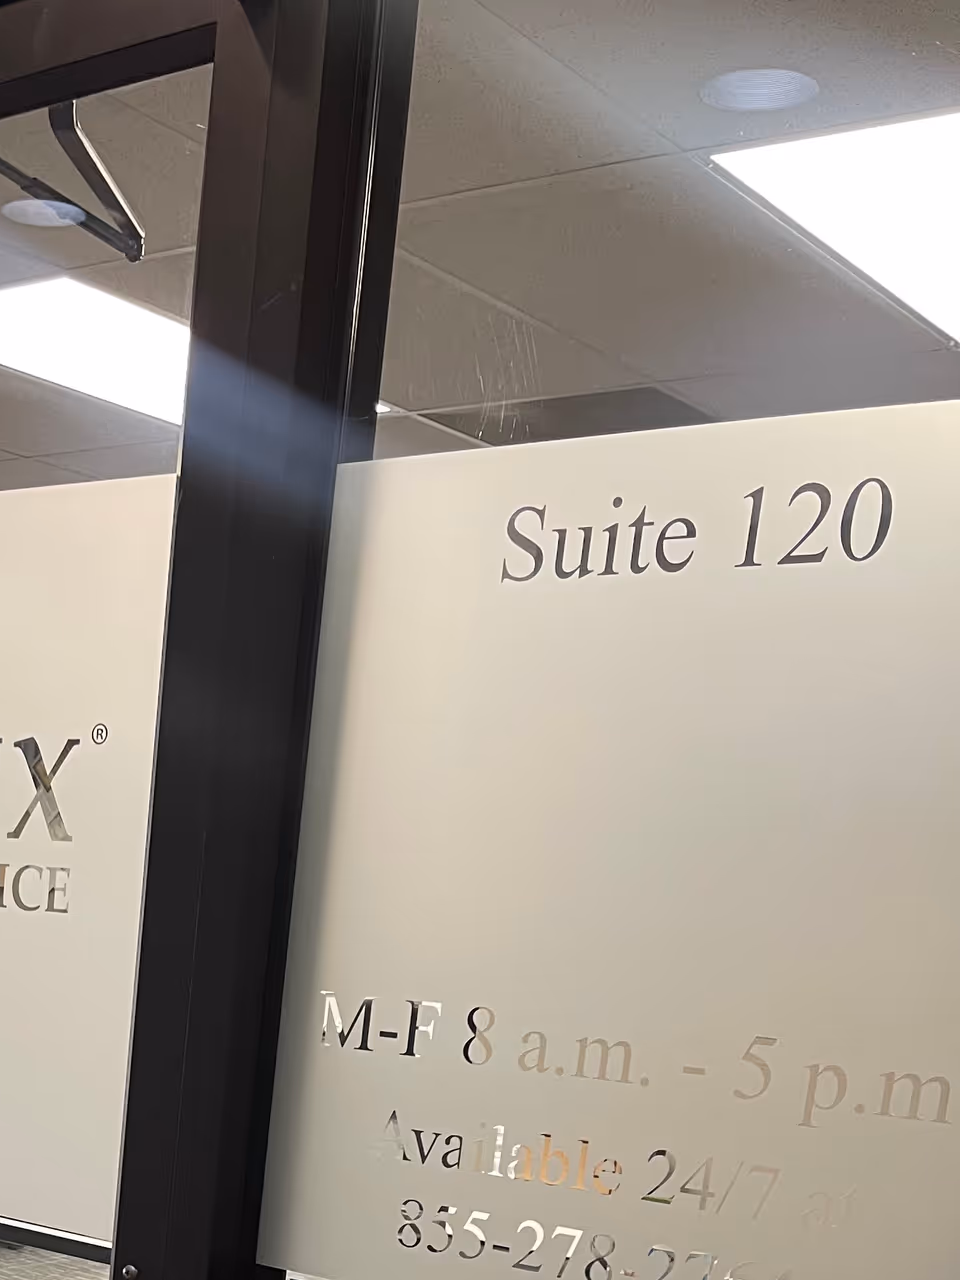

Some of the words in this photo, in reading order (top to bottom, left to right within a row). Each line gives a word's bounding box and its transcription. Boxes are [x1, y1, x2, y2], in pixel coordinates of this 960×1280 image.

[500, 496, 697, 583] Suite
[734, 477, 893, 567] 120
[320, 989, 443, 1058] M-F
[462, 1005, 496, 1065] 8
[517, 1029, 649, 1087] a.m.
[733, 1034, 779, 1100] 5
[375, 1109, 623, 1196] Available
[640, 1149, 783, 1221] 24/7
